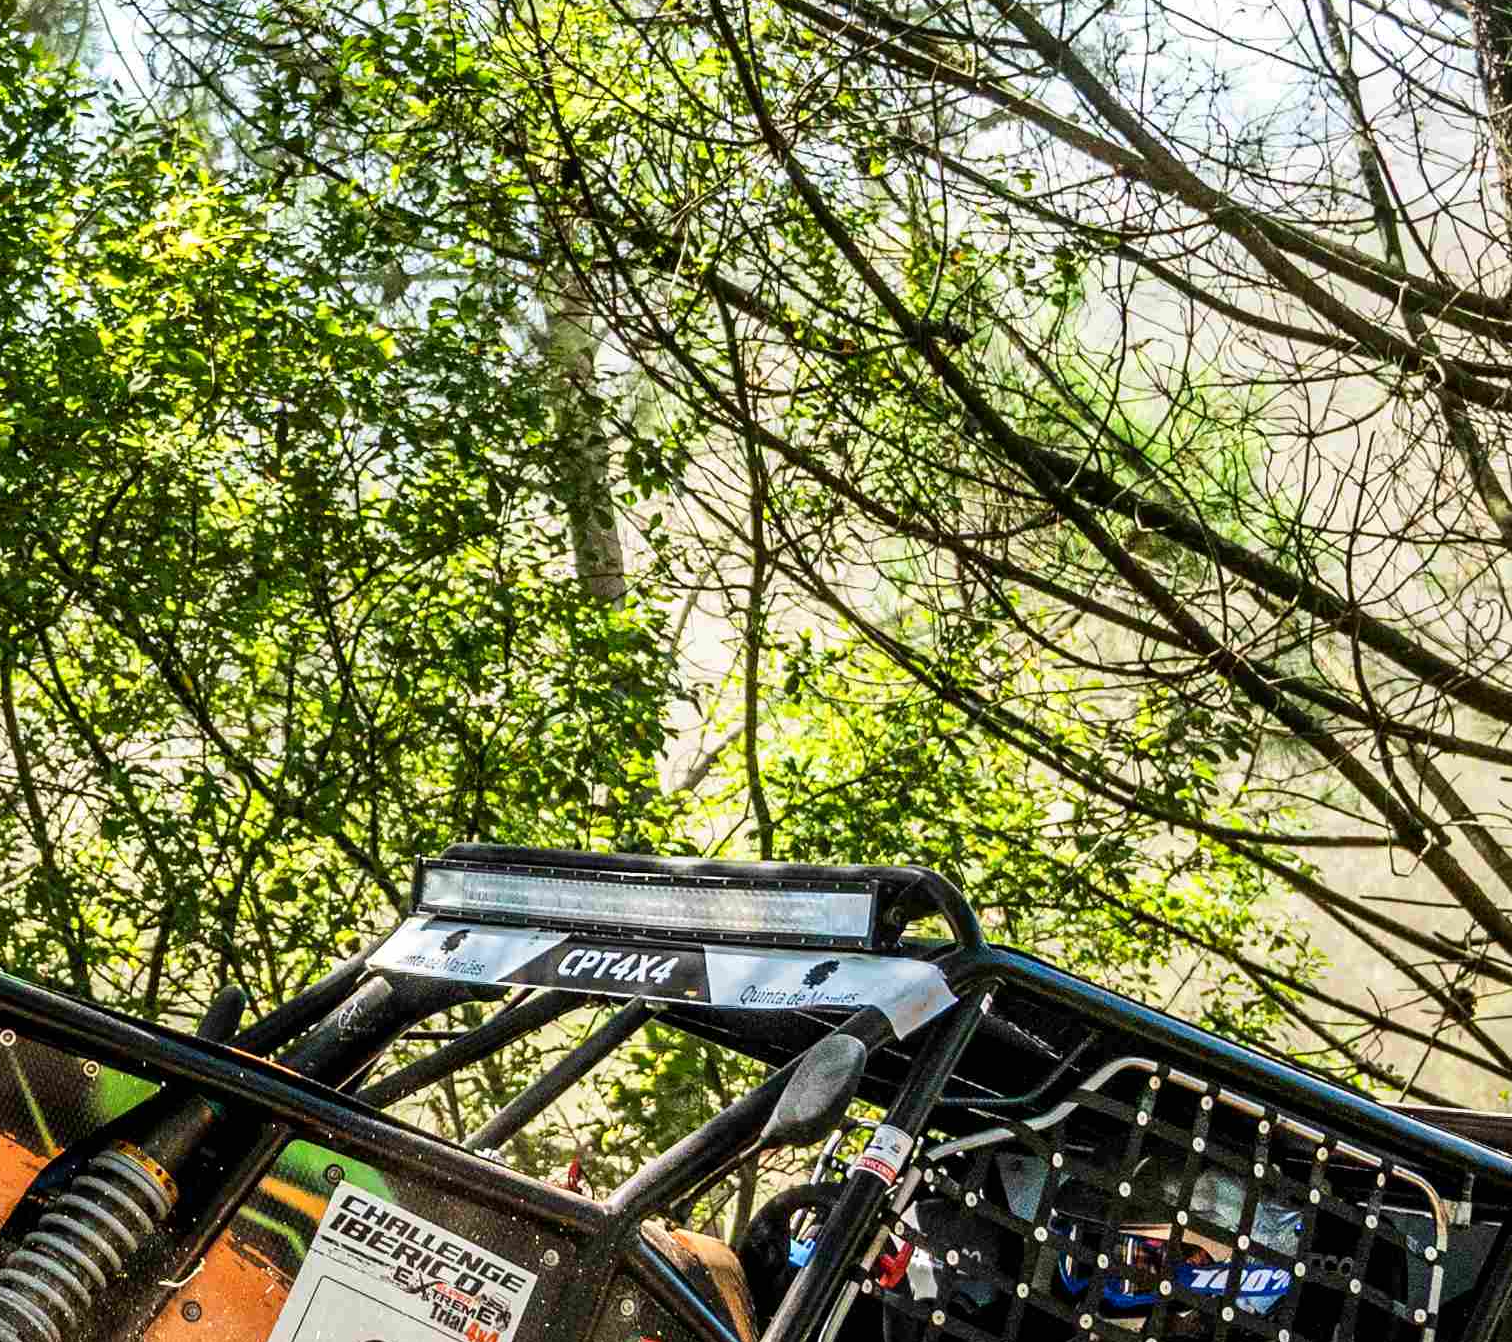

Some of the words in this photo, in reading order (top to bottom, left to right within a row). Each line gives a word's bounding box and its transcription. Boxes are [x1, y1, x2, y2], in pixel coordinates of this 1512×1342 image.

[557, 948, 679, 985] CPT4X4
[739, 984, 786, 1005] Quinta
[786, 989, 805, 1006] de
[329, 1213, 485, 1298] IBERICO
[339, 1194, 527, 1294] CHALLENGE
[429, 1302, 467, 1335] Trial
